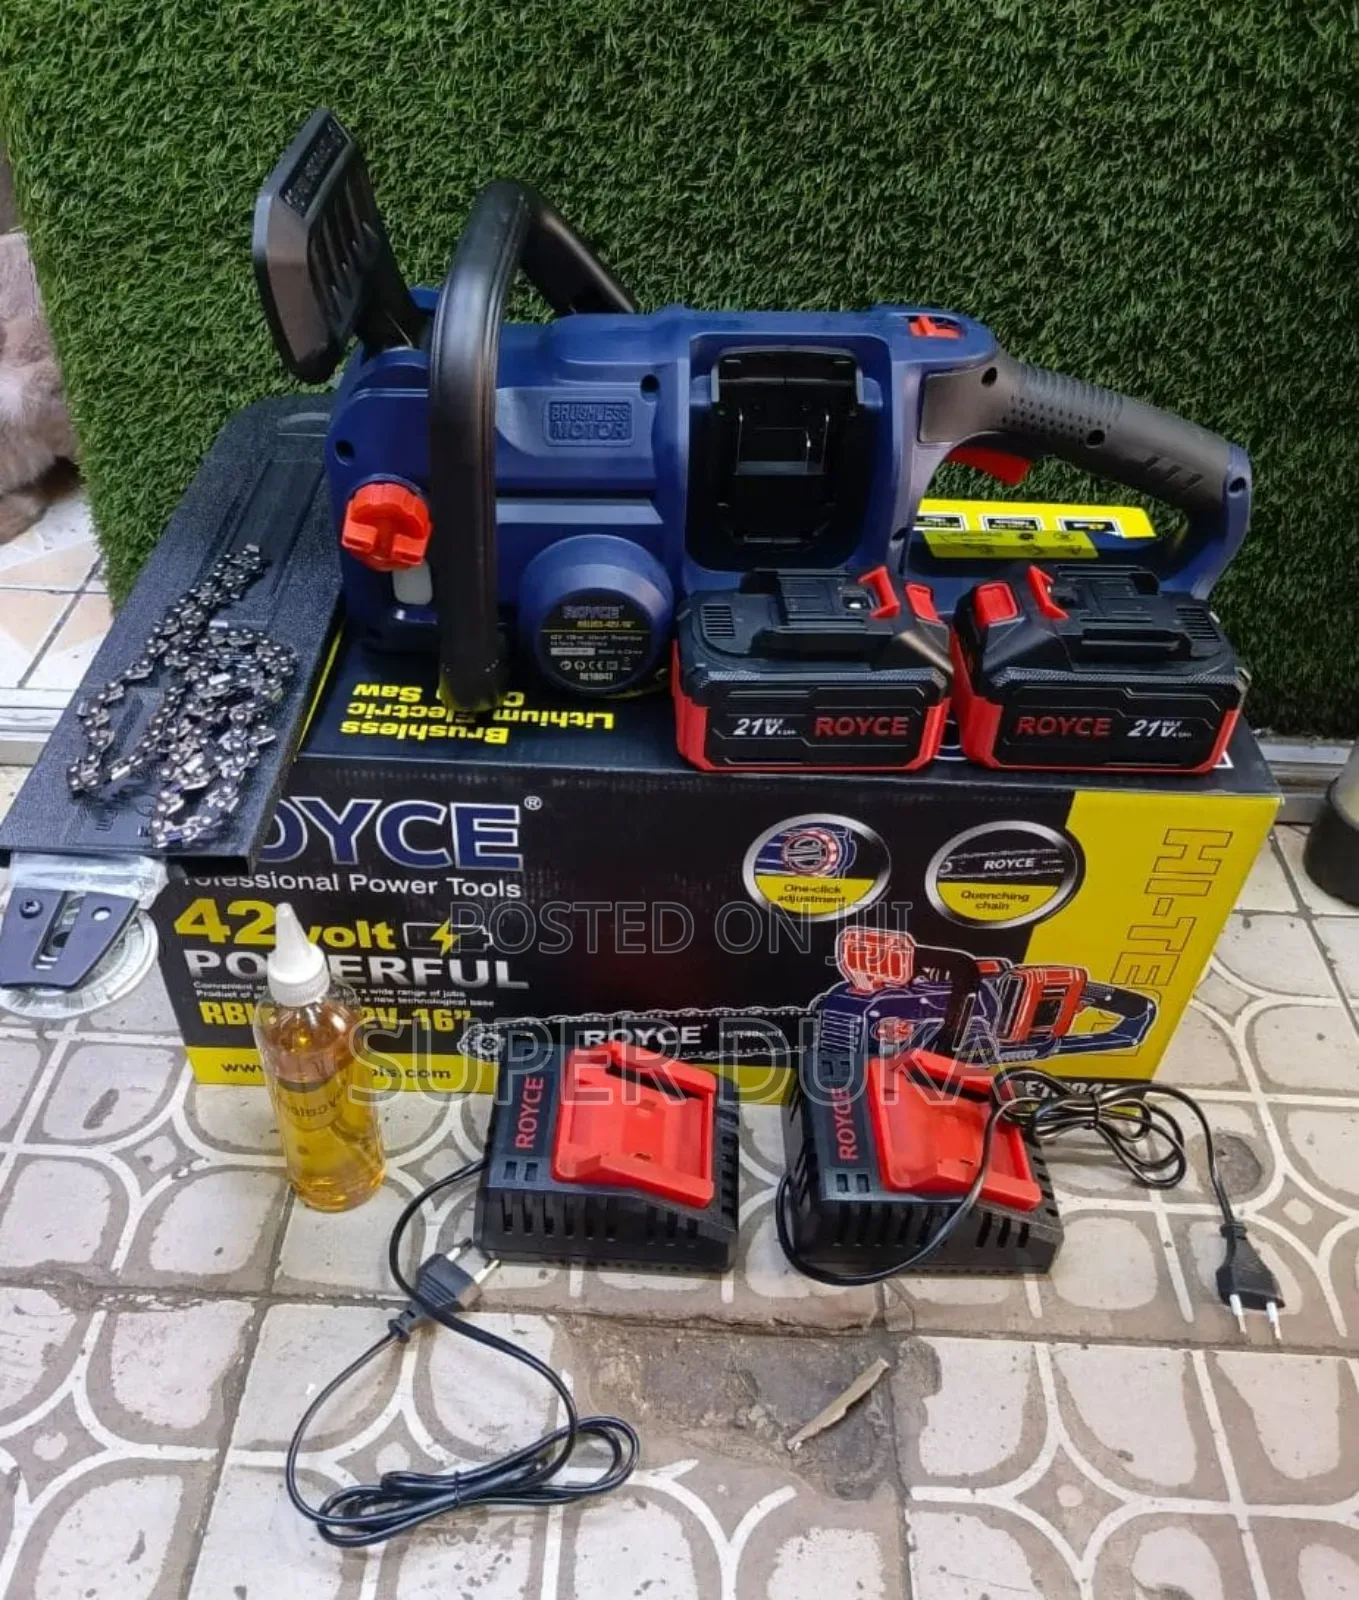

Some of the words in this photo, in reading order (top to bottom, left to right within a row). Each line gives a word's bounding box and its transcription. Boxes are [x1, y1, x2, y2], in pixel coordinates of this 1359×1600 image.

[550, 403, 630, 421] BRUSHLESS
[551, 421, 630, 440] MOTOR
[353, 683, 423, 702] Saw
[493, 709, 614, 730] Lithium
[815, 716, 910, 736] ROYCE
[1016, 716, 1113, 736] ROYCE
[340, 720, 510, 745] Brushless
[983, 857, 1036, 871] ROYCE
[349, 873, 438, 895] Power
[445, 876, 522, 898] Tools
[783, 883, 842, 894] One-click
[777, 894, 847, 905] adjustment
[960, 889, 1030, 903] Quenching
[975, 901, 1010, 911] chain
[174, 898, 277, 945] 42
[183, 949, 530, 990] POERFUL
[196, 989, 237, 997] Product
[370, 988, 394, 996] wide
[397, 990, 427, 999] range
[514, 1075, 545, 1149] ROYCE
[831, 1088, 860, 1161] ROYCE
